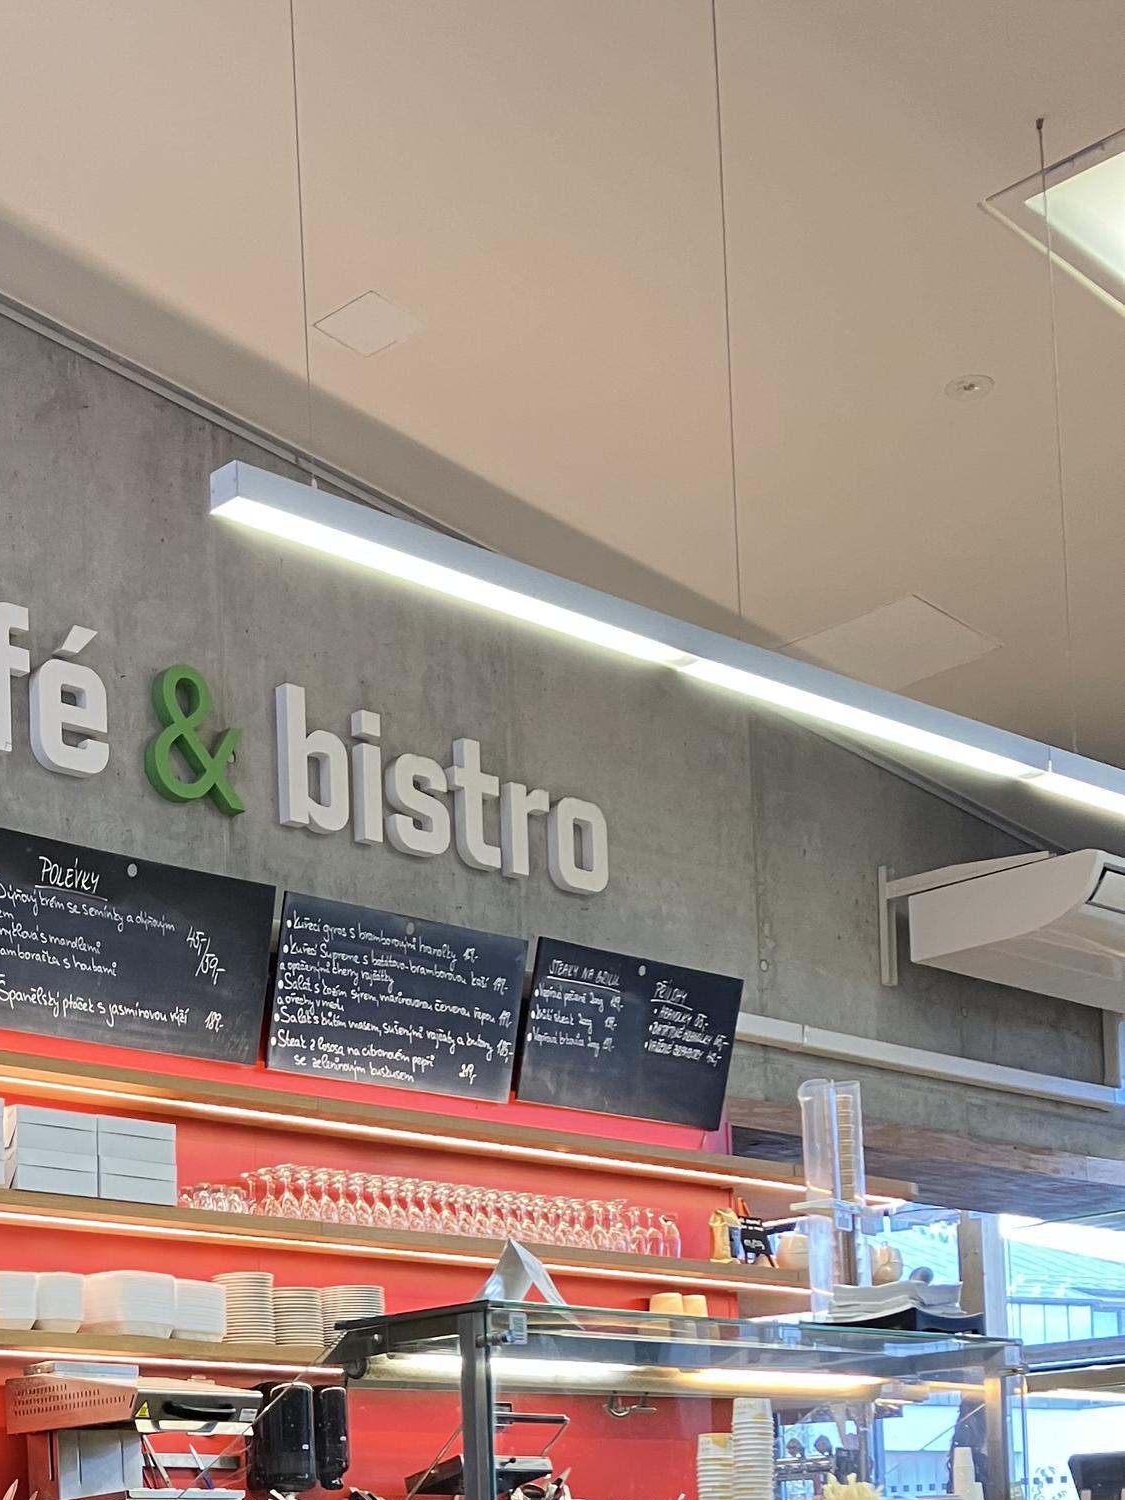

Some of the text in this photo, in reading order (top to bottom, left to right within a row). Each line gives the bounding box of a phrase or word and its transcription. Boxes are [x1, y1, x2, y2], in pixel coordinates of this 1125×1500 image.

[144, 664, 244, 816] &
[276, 682, 609, 895] bistro
[38, 856, 100, 894] POLÉVKY
[66, 901, 81, 915] se
[126, 915, 135, 925] a
[39, 932, 48, 946] s
[47, 935, 101, 955] mandlemi
[348, 927, 356, 939] s
[61, 956, 71, 971] s
[71, 954, 117, 977] houbami
[279, 961, 286, 972] a
[361, 954, 369, 966] s
[277, 995, 284, 1005] a
[314, 983, 320, 995] s
[96, 1003, 106, 1015] s
[105, 1002, 168, 1028] jasmínovou
[313, 1013, 320, 1025] s
[456, 1036, 466, 1047] a
[277, 1028, 307, 1049] Steak
[316, 1036, 346, 1056] lososa
[346, 1045, 360, 1056] na
[293, 1053, 307, 1066] se
